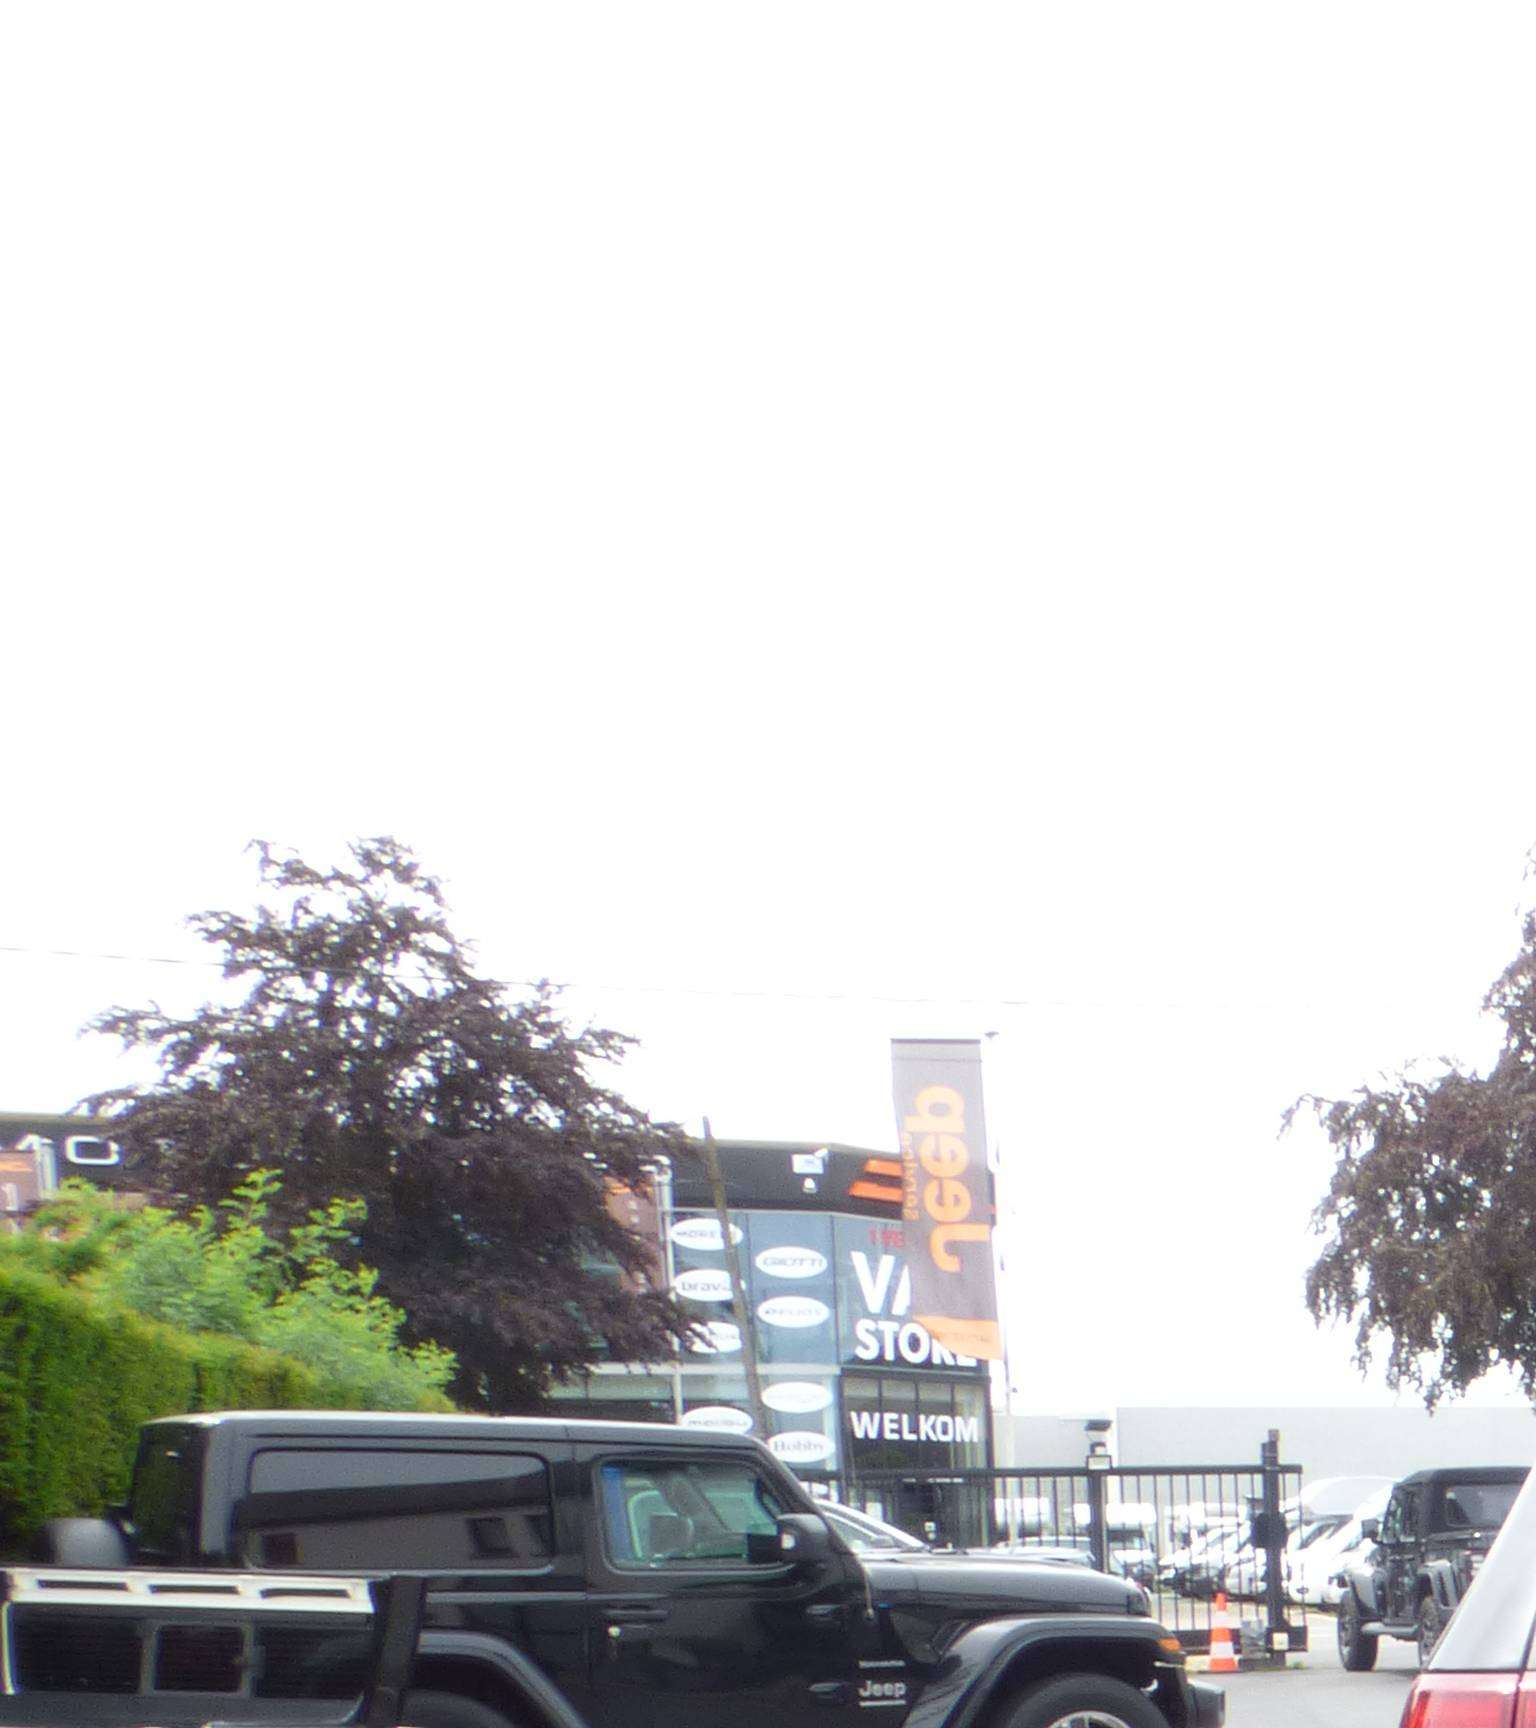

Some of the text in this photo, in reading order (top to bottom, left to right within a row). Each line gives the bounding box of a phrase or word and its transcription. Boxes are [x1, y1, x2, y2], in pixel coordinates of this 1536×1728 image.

[855, 1318, 979, 1367] STO
[850, 1411, 979, 1443] WELKOM
[858, 1680, 906, 1697] Jeep
